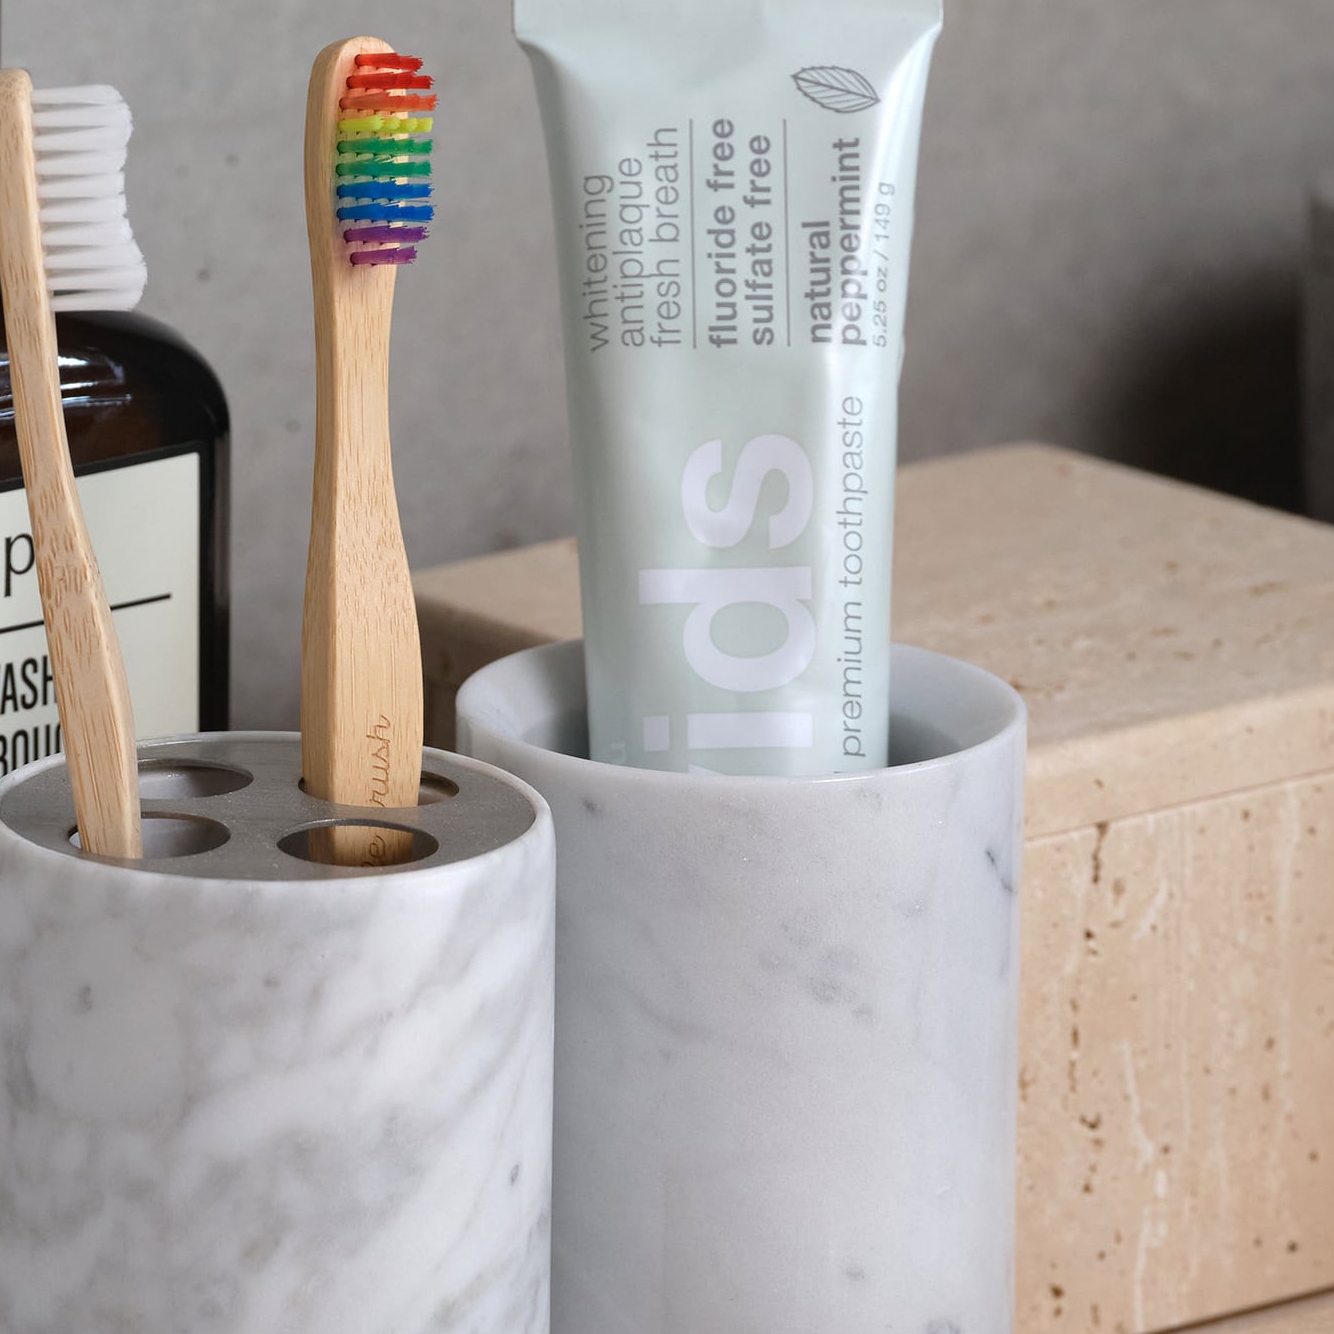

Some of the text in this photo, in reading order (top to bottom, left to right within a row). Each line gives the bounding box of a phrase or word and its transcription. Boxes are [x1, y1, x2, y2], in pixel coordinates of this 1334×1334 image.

[580, 174, 614, 352] whitening
[612, 157, 650, 347] antiplaque
[647, 127, 681, 347] fresh breath
[706, 118, 738, 348] fluoride free
[744, 135, 775, 346] sulfate free
[802, 220, 833, 344] natural
[831, 137, 868, 346] peppermint
[875, 203, 890, 240] 149
[877, 267, 889, 293] oz
[879, 182, 895, 196] g
[873, 299, 888, 348] 5.25
[639, 434, 818, 774] ids
[836, 395, 868, 758] premium toothpaste
